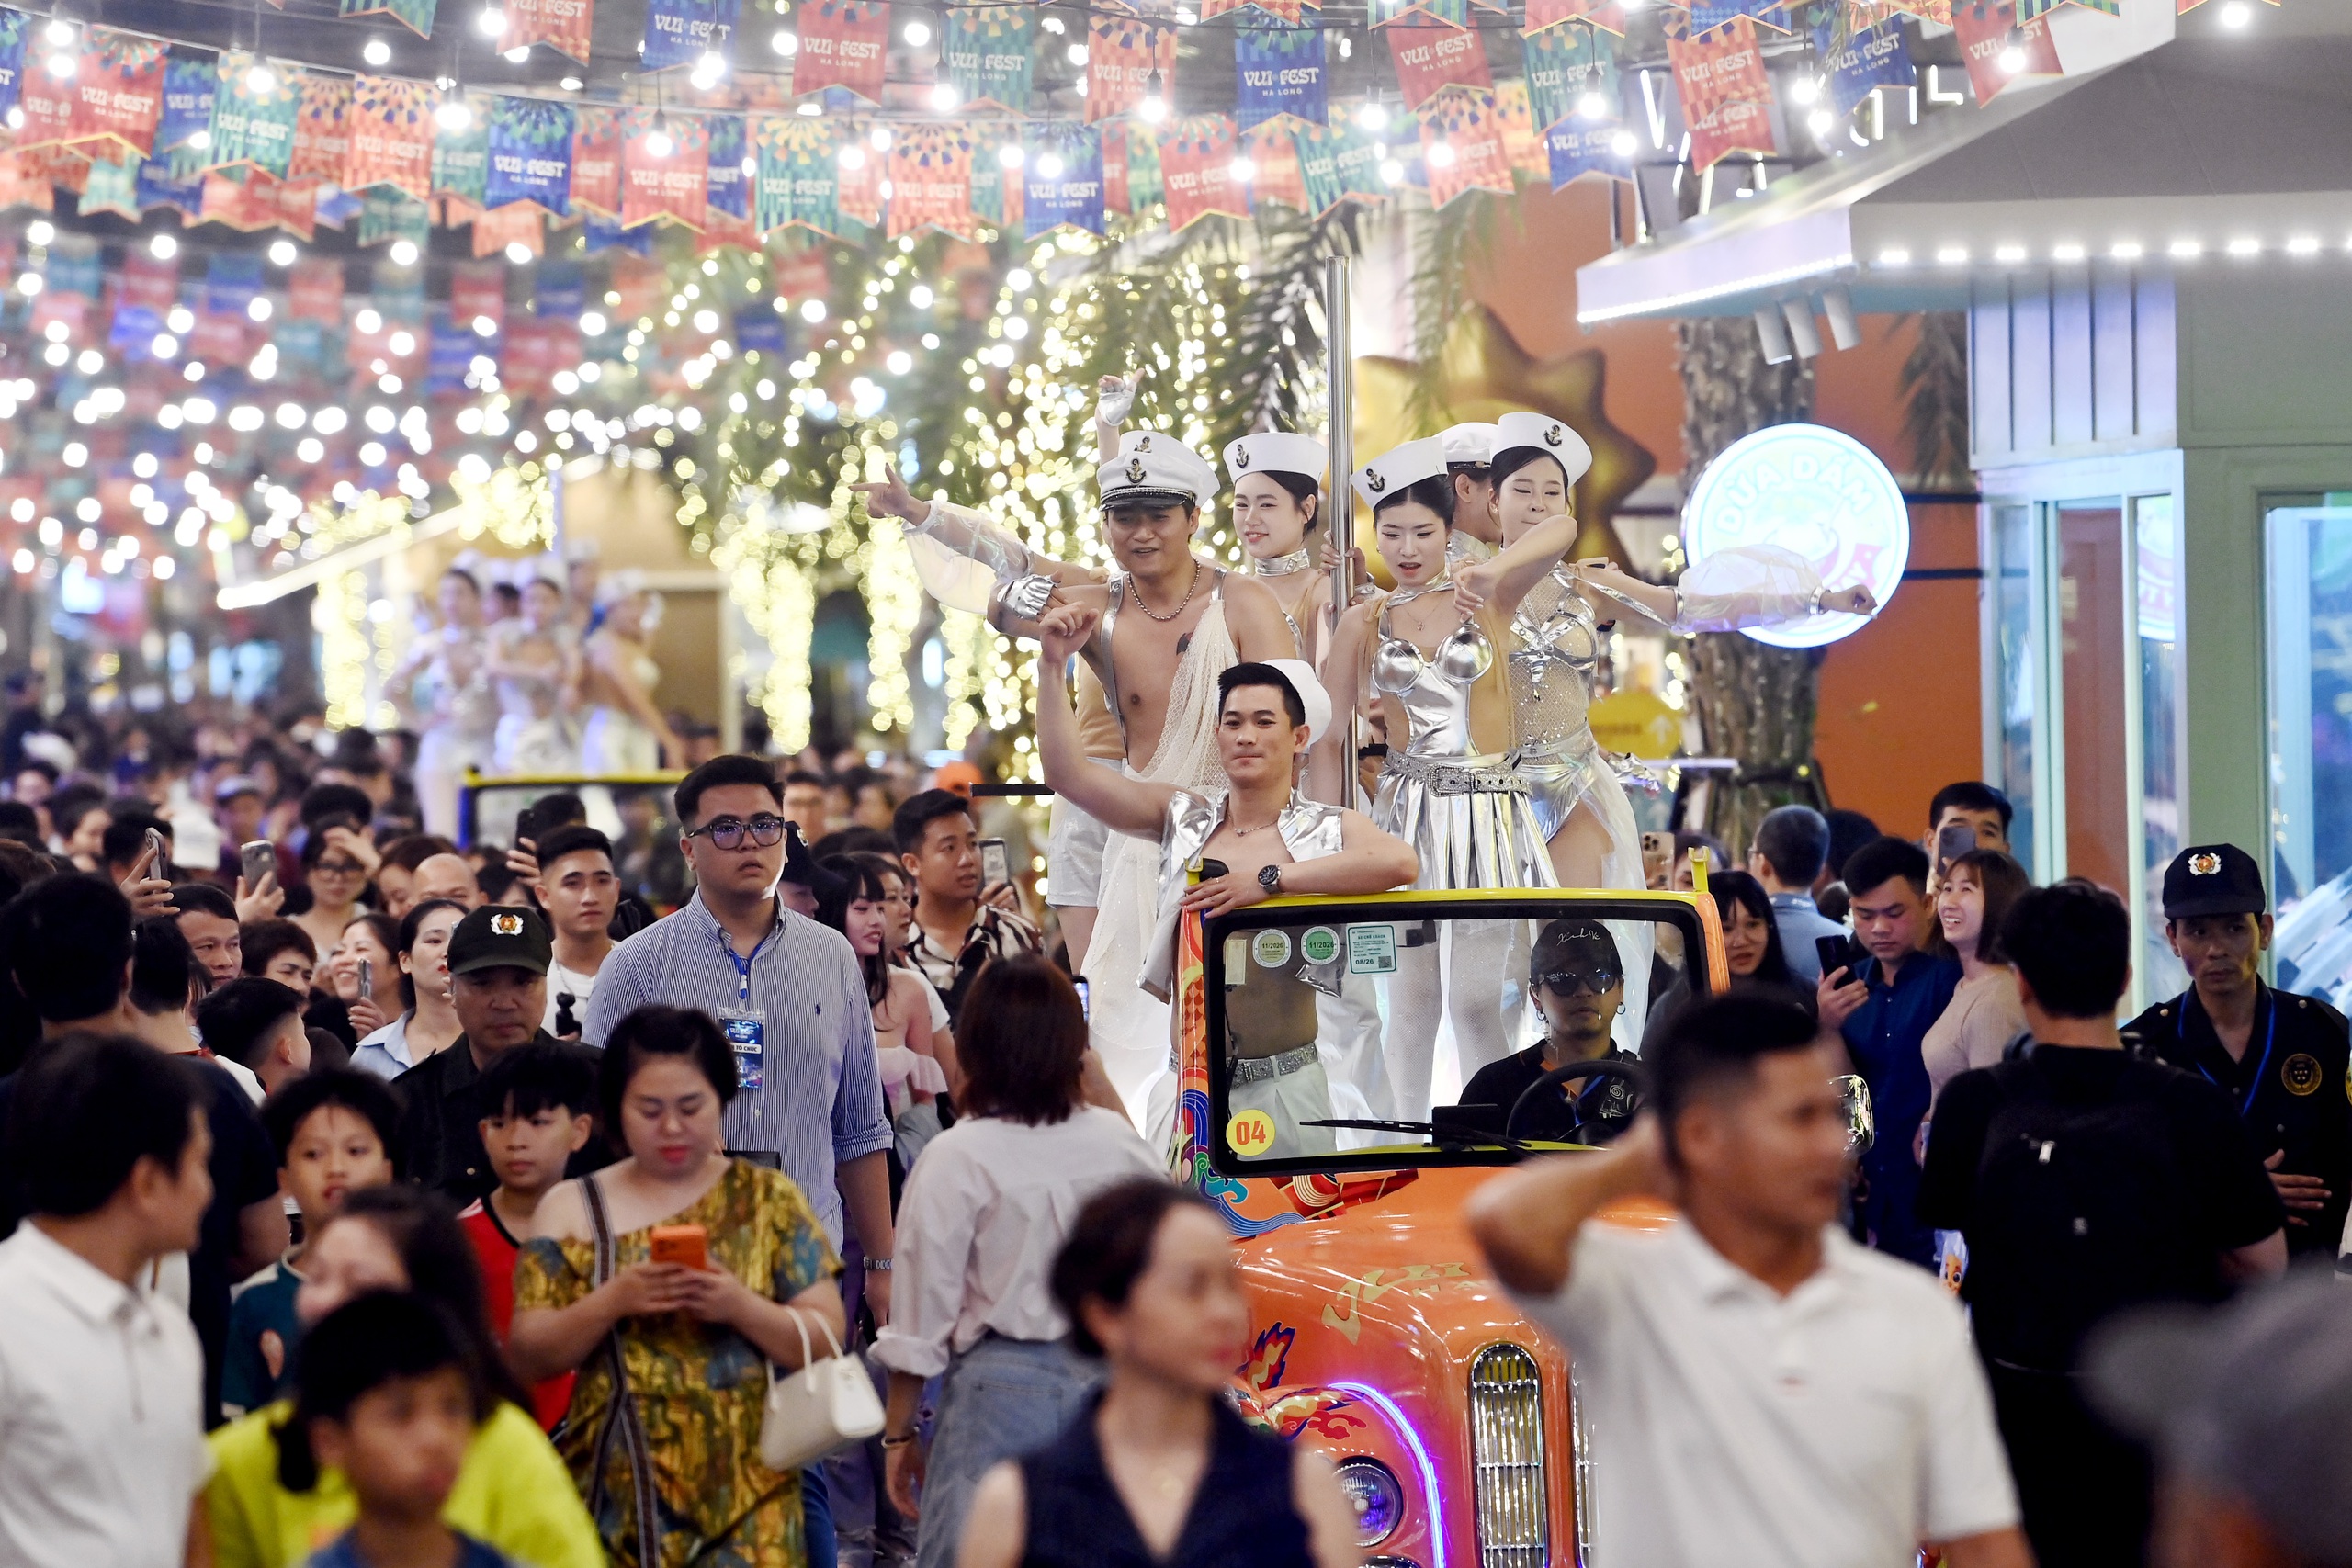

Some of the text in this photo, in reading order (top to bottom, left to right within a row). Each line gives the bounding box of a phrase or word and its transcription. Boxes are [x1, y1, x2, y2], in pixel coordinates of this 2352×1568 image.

[654, 15, 683, 34] VUI
[804, 37, 880, 59] VUI FEST
[1400, 32, 1474, 66] VUI FEST
[1863, 32, 1900, 60] FEST
[1969, 38, 1997, 60] VUI
[835, 59, 861, 68] LONG
[949, 52, 1025, 71] VUI FEST
[1436, 57, 1462, 68] LONG
[1680, 50, 1755, 84] VUI FEST
[1852, 57, 1890, 75] HA LONG
[981, 73, 1006, 81] LONG
[1094, 64, 1122, 82] VUI
[1244, 67, 1319, 87] VUI FEST
[1532, 69, 1560, 88] VUI
[1702, 72, 1743, 89] HA LONG
[81, 85, 154, 114] VUI FEST
[1278, 87, 1303, 96] LONG
[1723, 104, 1758, 124] FEST
[217, 114, 245, 132] VUI
[250, 119, 290, 141] FEST
[355, 134, 383, 153] VUI
[389, 140, 428, 159] FEST
[1552, 133, 1578, 151] VUI
[494, 154, 566, 178] VUI FEST
[1305, 157, 1334, 176] VUI
[1337, 146, 1374, 168] FEST
[630, 169, 703, 190] VUI FEST
[763, 178, 791, 194] VUI
[796, 179, 833, 196] FEST
[1168, 172, 1196, 190] VUI
[895, 182, 965, 199] VUI FEST
[1029, 181, 1099, 199] VUI FEST
[1059, 200, 1084, 209] LONG
[1309, 941, 1335, 949] 11/2026
[1236, 1120, 1266, 1145] 04
